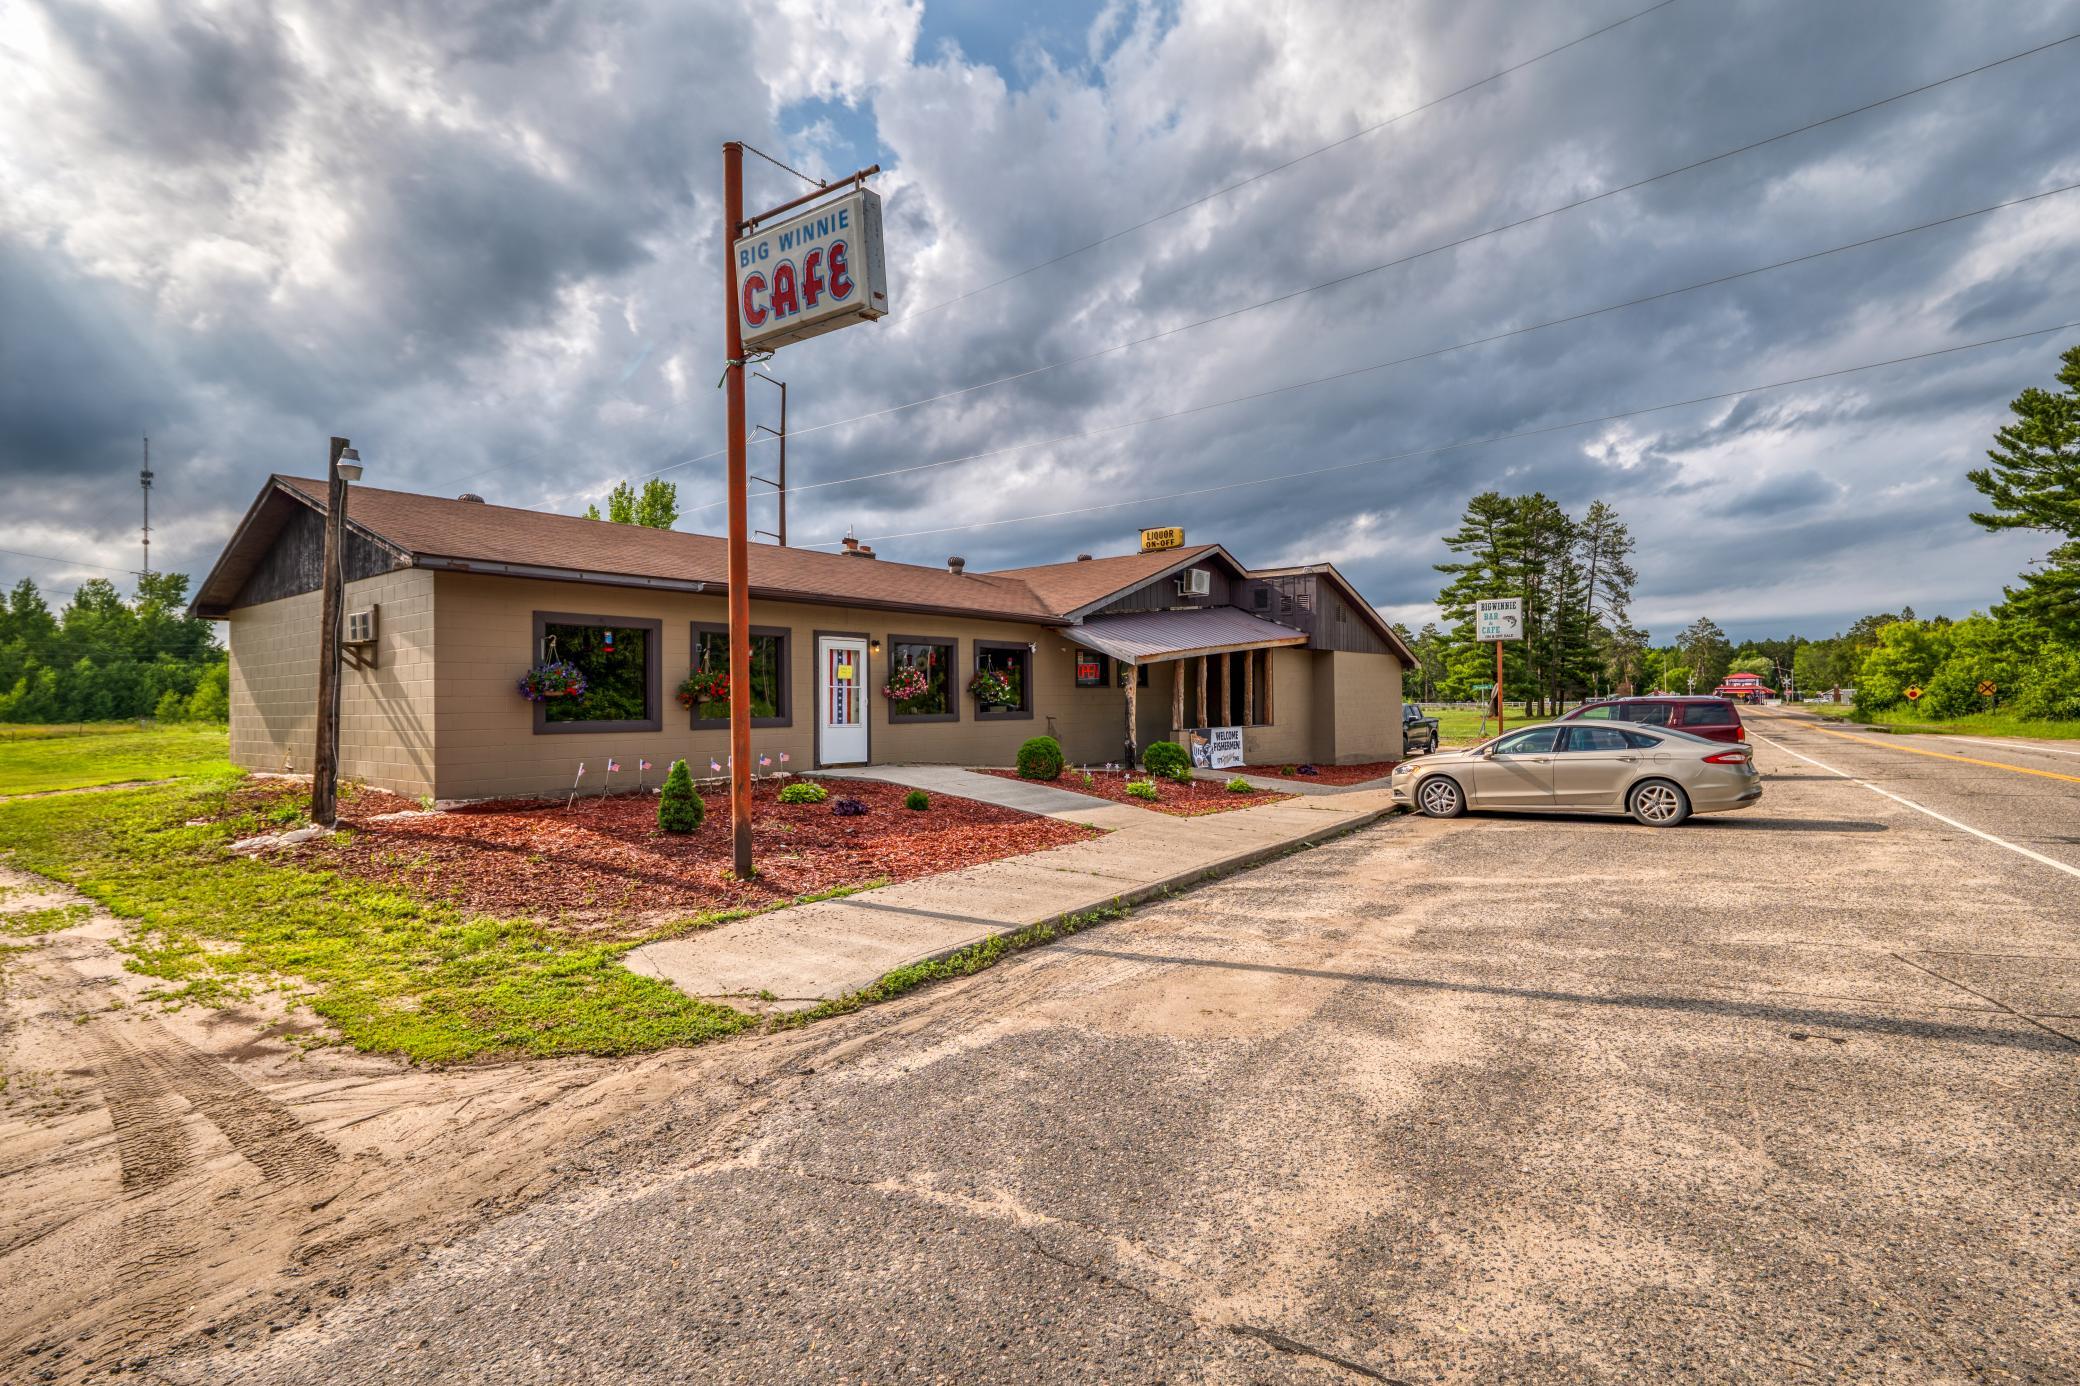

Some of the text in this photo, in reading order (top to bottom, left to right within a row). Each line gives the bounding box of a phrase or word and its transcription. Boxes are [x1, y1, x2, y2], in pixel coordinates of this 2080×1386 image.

[740, 208, 849, 268] BIG WINNIE
[742, 239, 855, 328] CAFE
[1146, 530, 1174, 541] LIQUOR
[1145, 539, 1175, 548] ON-OFF
[1484, 612, 1498, 620] BAR
[1481, 626, 1501, 634] CAFE
[1215, 730, 1239, 741] WELCOME
